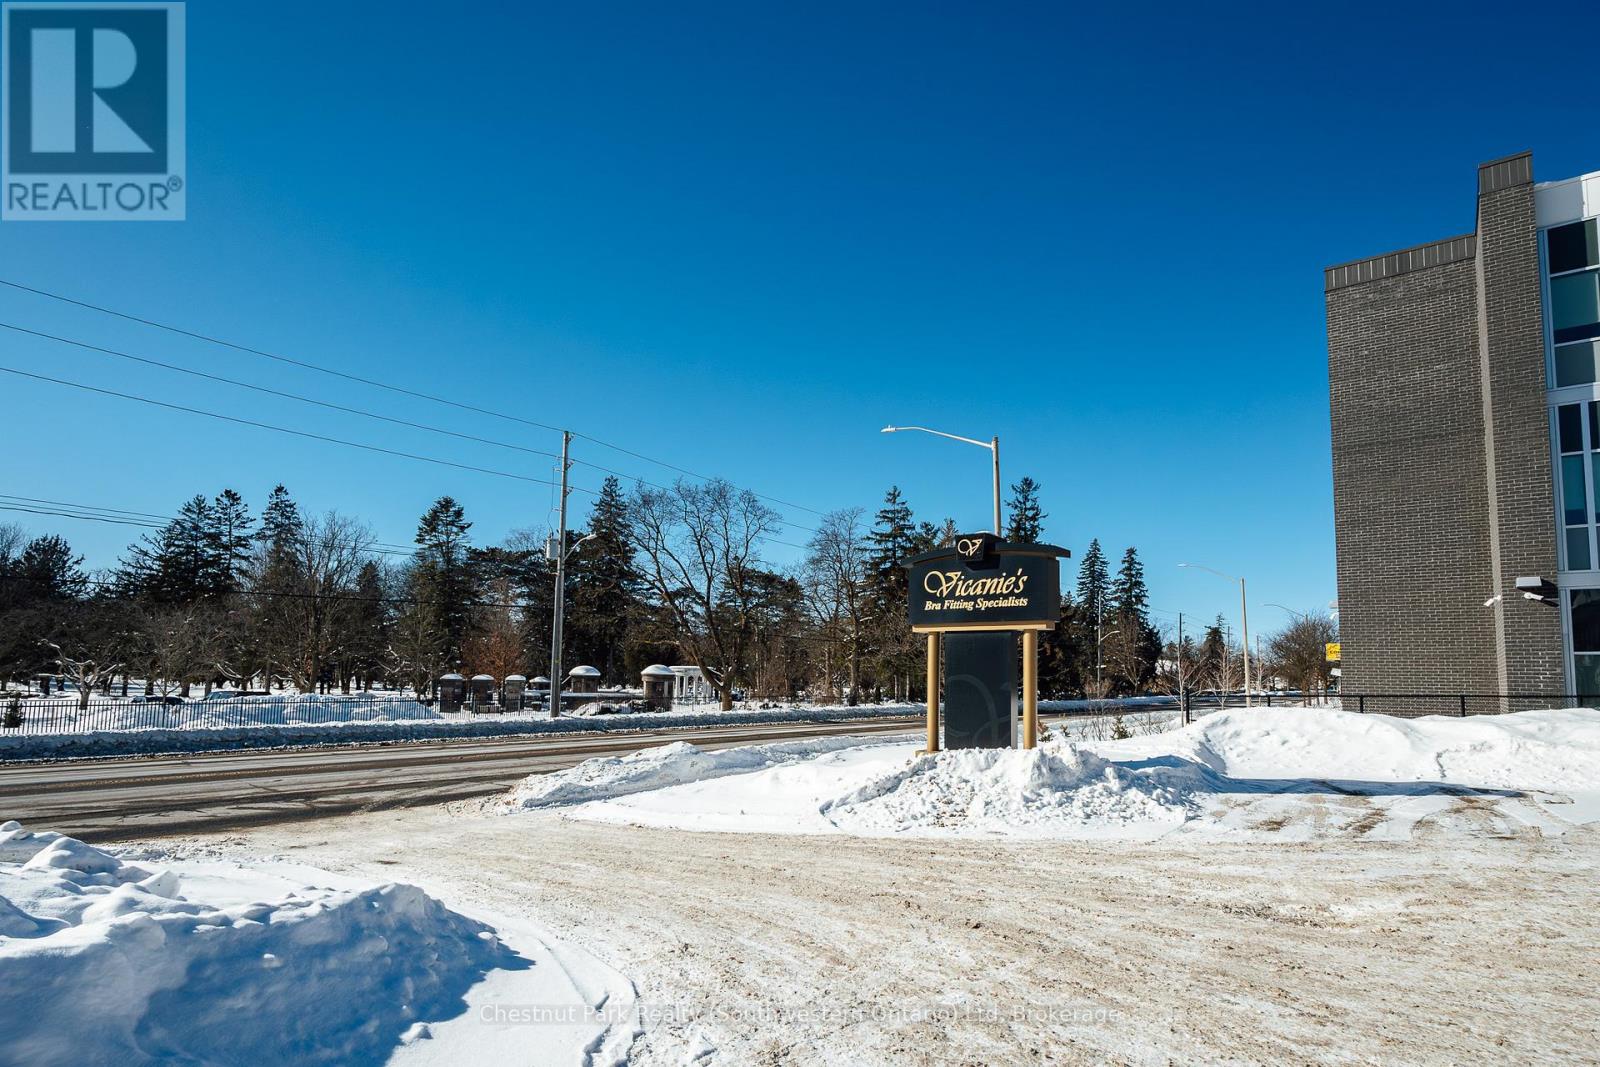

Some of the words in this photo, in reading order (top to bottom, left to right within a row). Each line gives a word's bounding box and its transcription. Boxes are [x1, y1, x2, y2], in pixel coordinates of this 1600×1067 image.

[924, 568, 1028, 597] Vicanie's
[924, 600, 941, 611] Bra
[943, 599, 974, 611] Fitting
[975, 596, 1028, 610] Specialists
